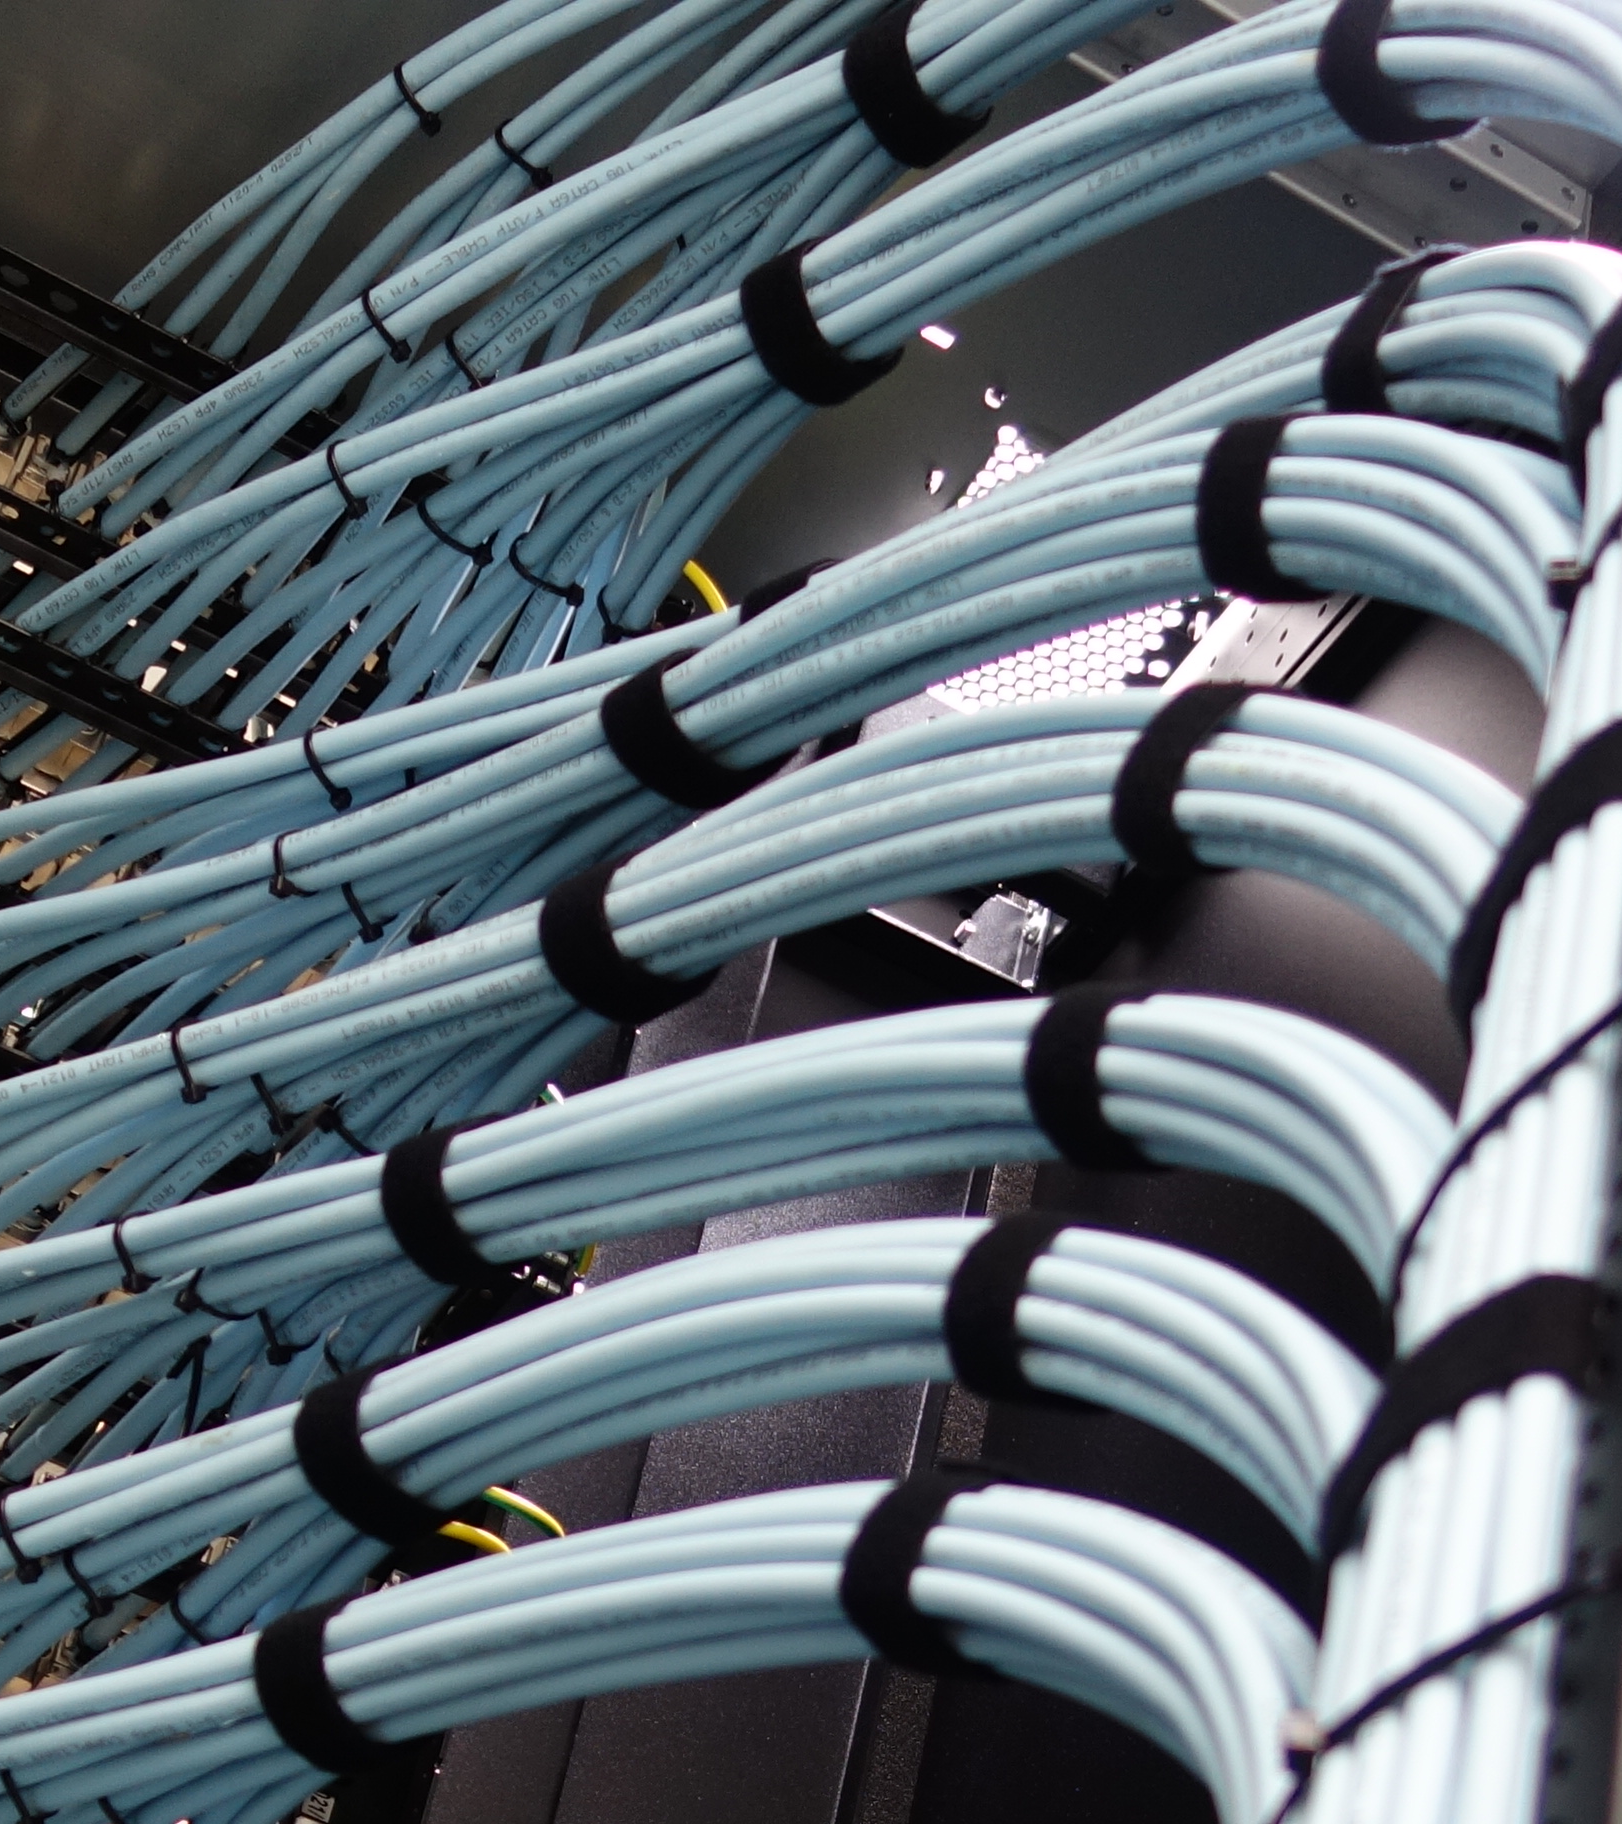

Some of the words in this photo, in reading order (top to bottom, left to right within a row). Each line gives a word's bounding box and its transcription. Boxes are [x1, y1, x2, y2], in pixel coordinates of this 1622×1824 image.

[548, 176, 599, 209] CAT6A
[492, 203, 543, 240] F/UTP
[582, 255, 621, 286] LINK
[290, 293, 385, 359] U-9266LSZH
[503, 307, 548, 345] CAT6A
[192, 397, 219, 419] 4PR
[154, 414, 190, 441] LSZH
[108, 547, 141, 575] LINK
[18, 1066, 77, 1095] 0121-4
